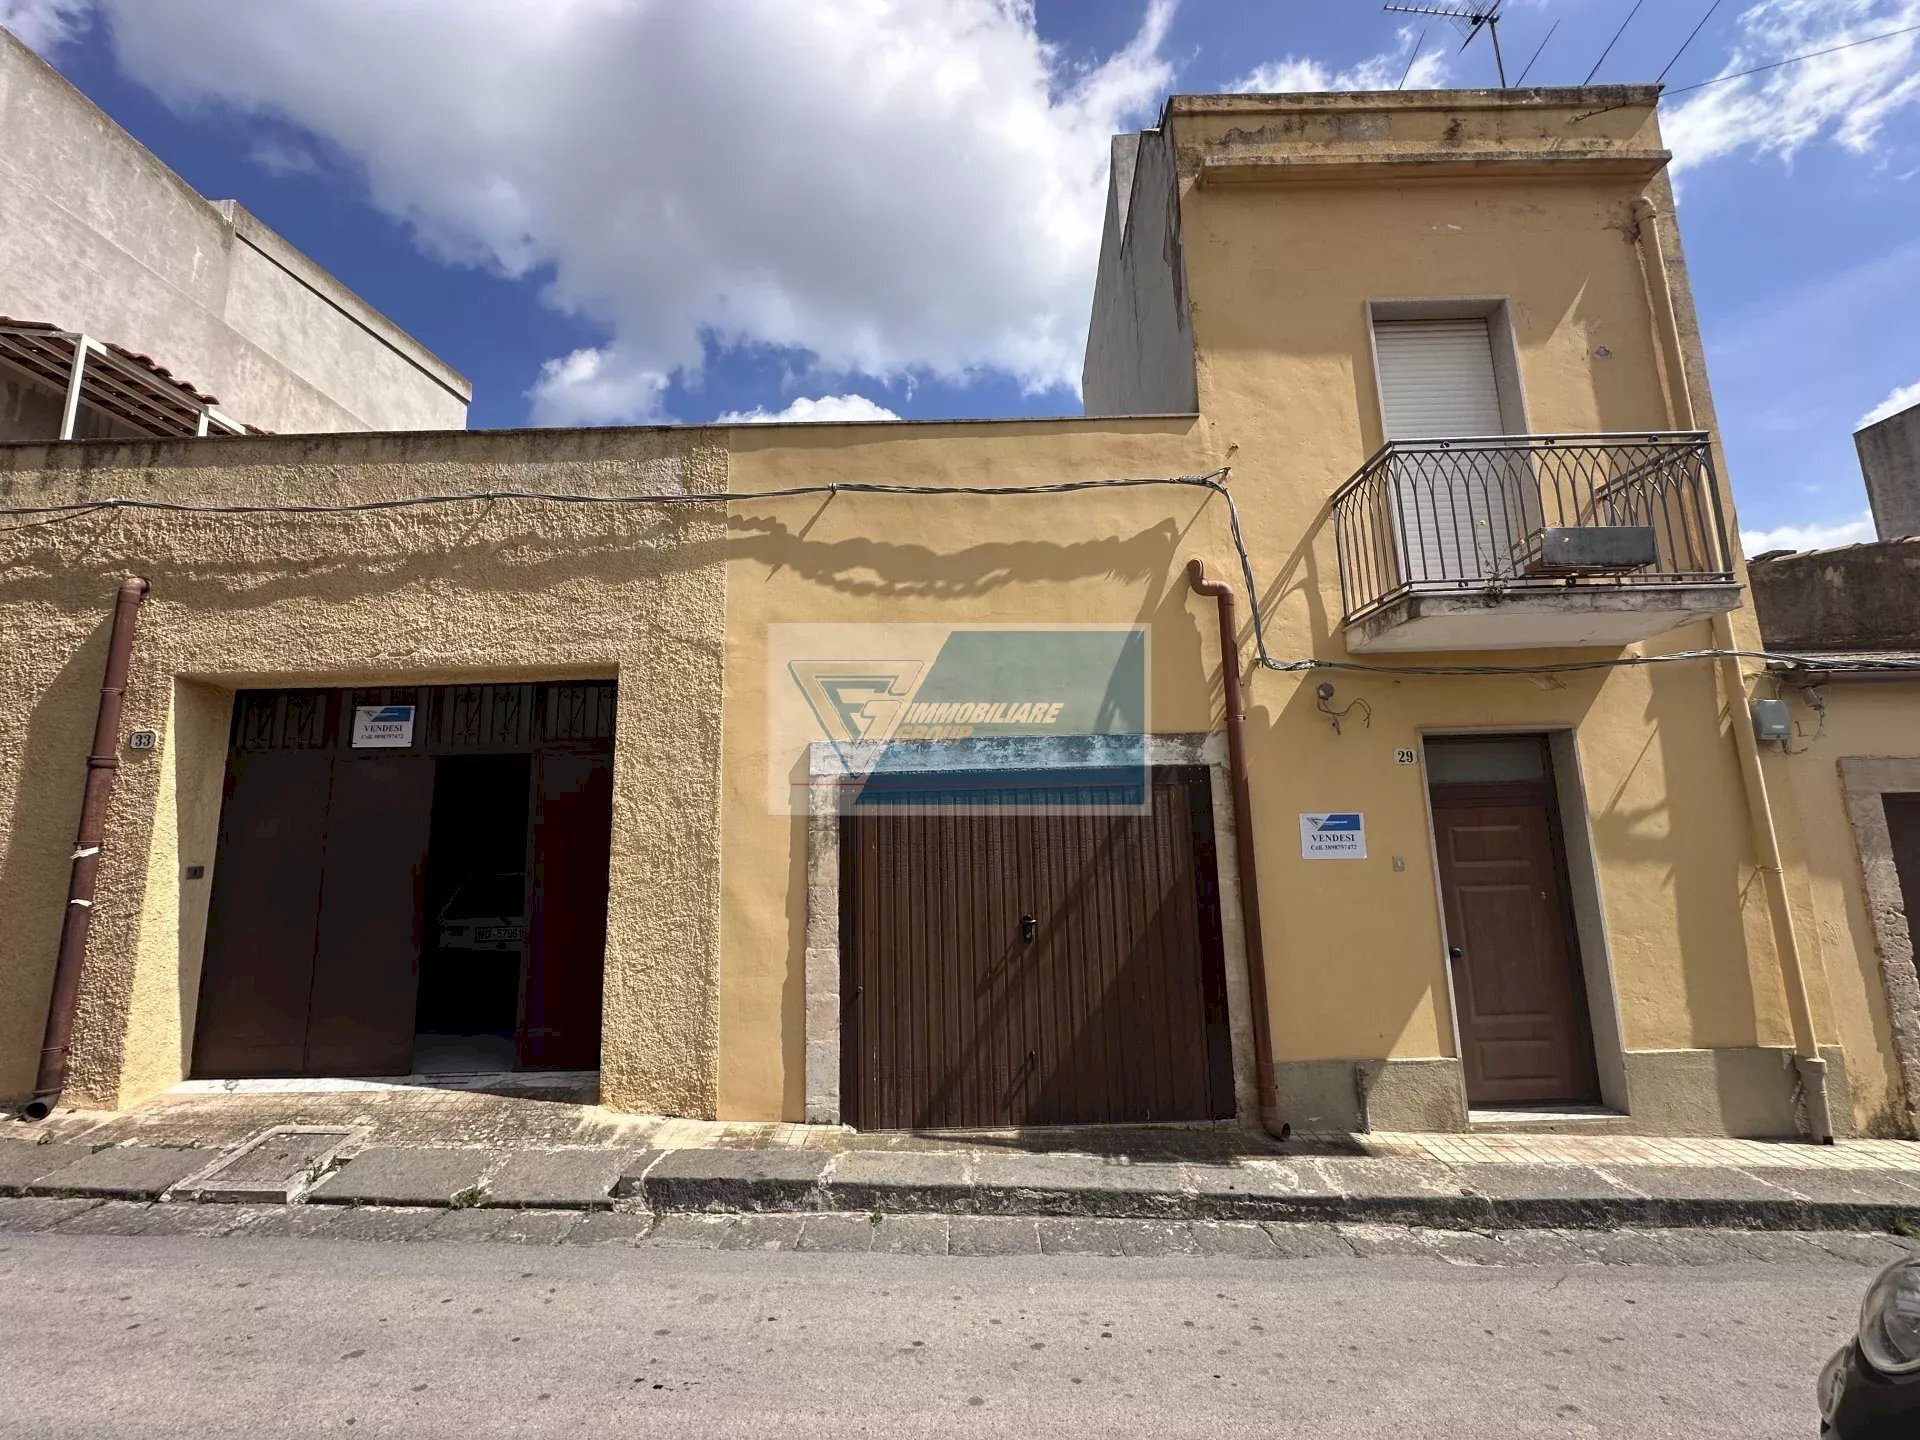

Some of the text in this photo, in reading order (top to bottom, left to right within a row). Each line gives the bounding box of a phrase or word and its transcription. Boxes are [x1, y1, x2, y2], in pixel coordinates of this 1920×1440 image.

[364, 724, 403, 732] VENDESI
[135, 734, 151, 747] 33
[1397, 750, 1414, 763] 29
[1311, 834, 1355, 842] VENDESI
